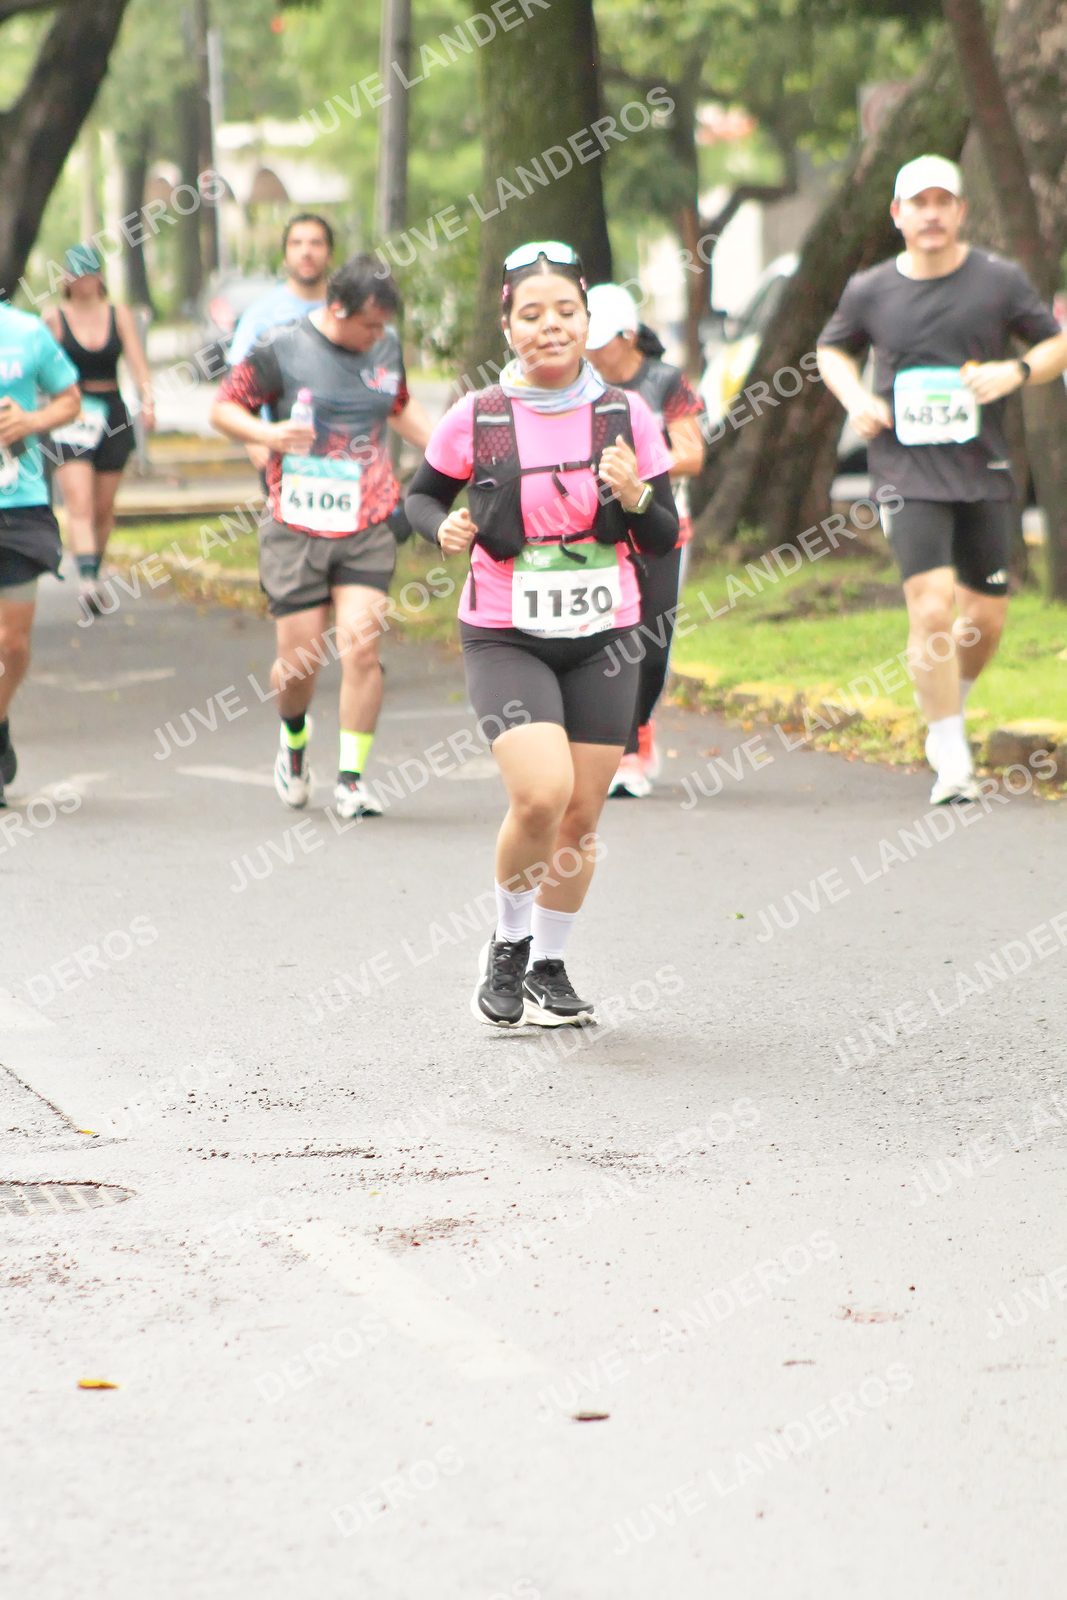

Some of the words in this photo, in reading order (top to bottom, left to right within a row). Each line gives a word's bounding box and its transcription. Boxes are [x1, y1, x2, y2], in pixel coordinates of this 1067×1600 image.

[903, 405, 969, 426] 4834
[289, 490, 352, 511] 4106
[523, 586, 613, 618] 1130
